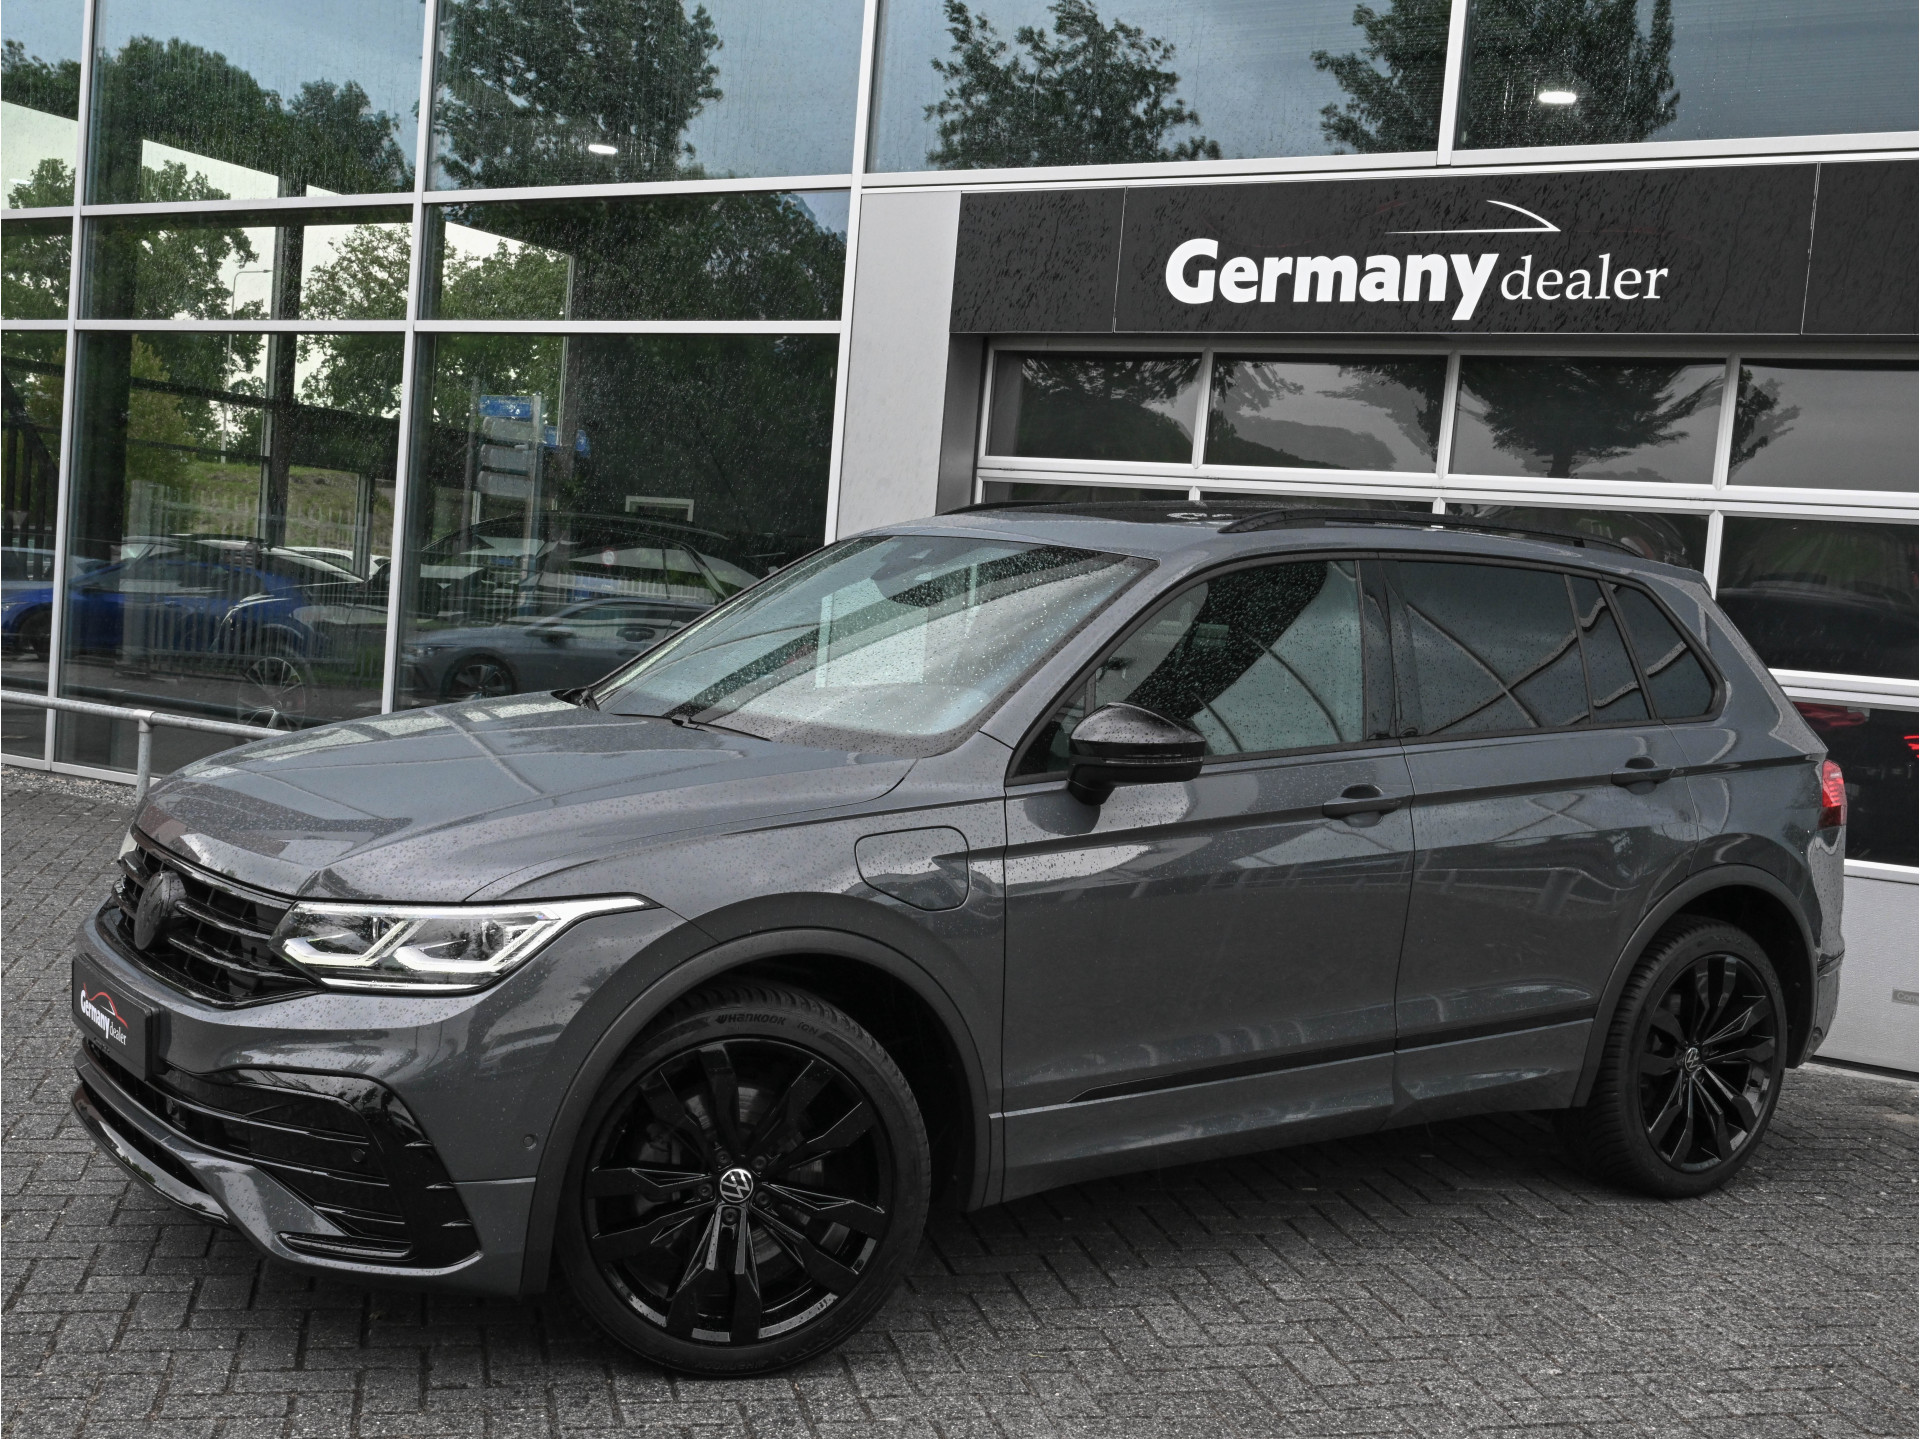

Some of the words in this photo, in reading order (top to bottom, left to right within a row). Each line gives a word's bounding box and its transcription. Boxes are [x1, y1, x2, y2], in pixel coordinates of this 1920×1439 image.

[1165, 237, 1500, 321] Germany
[1500, 252, 1669, 300] dealer
[80, 989, 110, 1039] Germany
[109, 1021, 127, 1046] dealer
